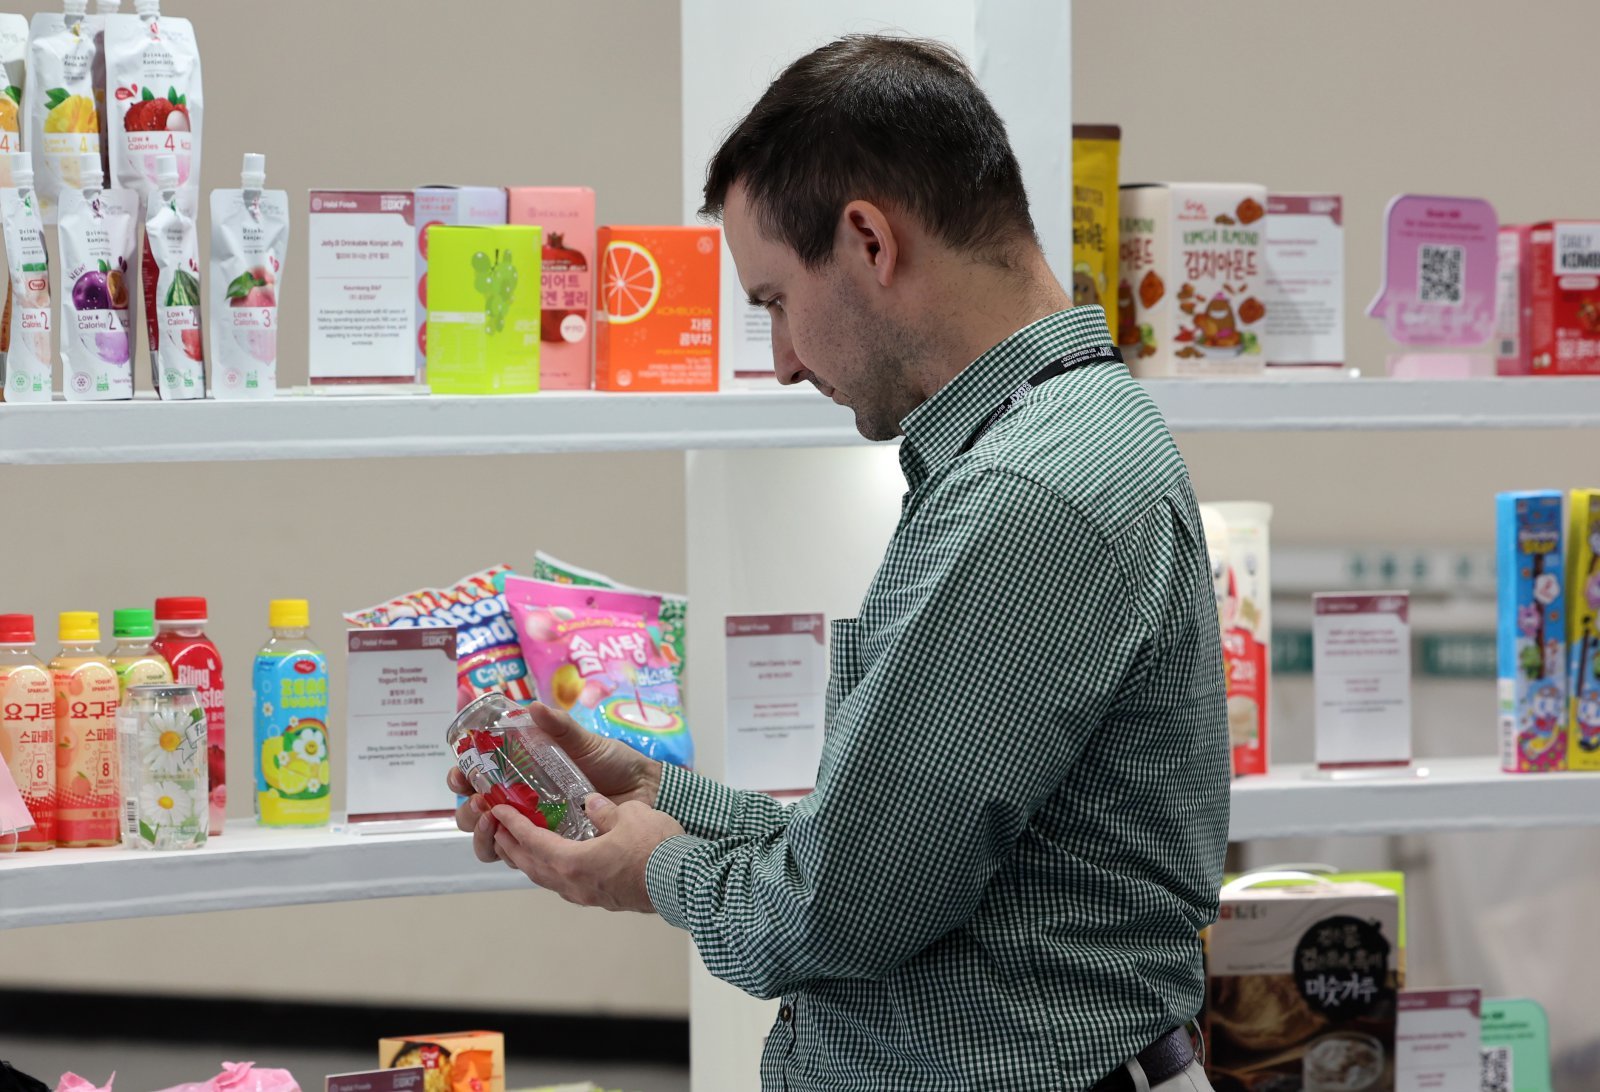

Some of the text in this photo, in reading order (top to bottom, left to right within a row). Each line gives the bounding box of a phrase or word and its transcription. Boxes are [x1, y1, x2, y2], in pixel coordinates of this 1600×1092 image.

[79, 136, 88, 152] 4
[164, 134, 175, 152] 4
[1183, 249, 1257, 280] 김치아몬드
[40, 312, 49, 330] 2
[108, 312, 116, 330] 2
[262, 309, 271, 328] 3
[569, 631, 647, 675] 솜사탕
[178, 665, 210, 689] Bling
[378, 676, 427, 685] Yogurt Sparkling
[382, 668, 398, 676] Bling
[476, 661, 520, 684] Cake
[4, 702, 56, 721] 요구르
[71, 701, 117, 720] 요구르
[36, 764, 44, 779] 8
[102, 762, 110, 777] 8
[1305, 973, 1379, 1006] 미숫가루
